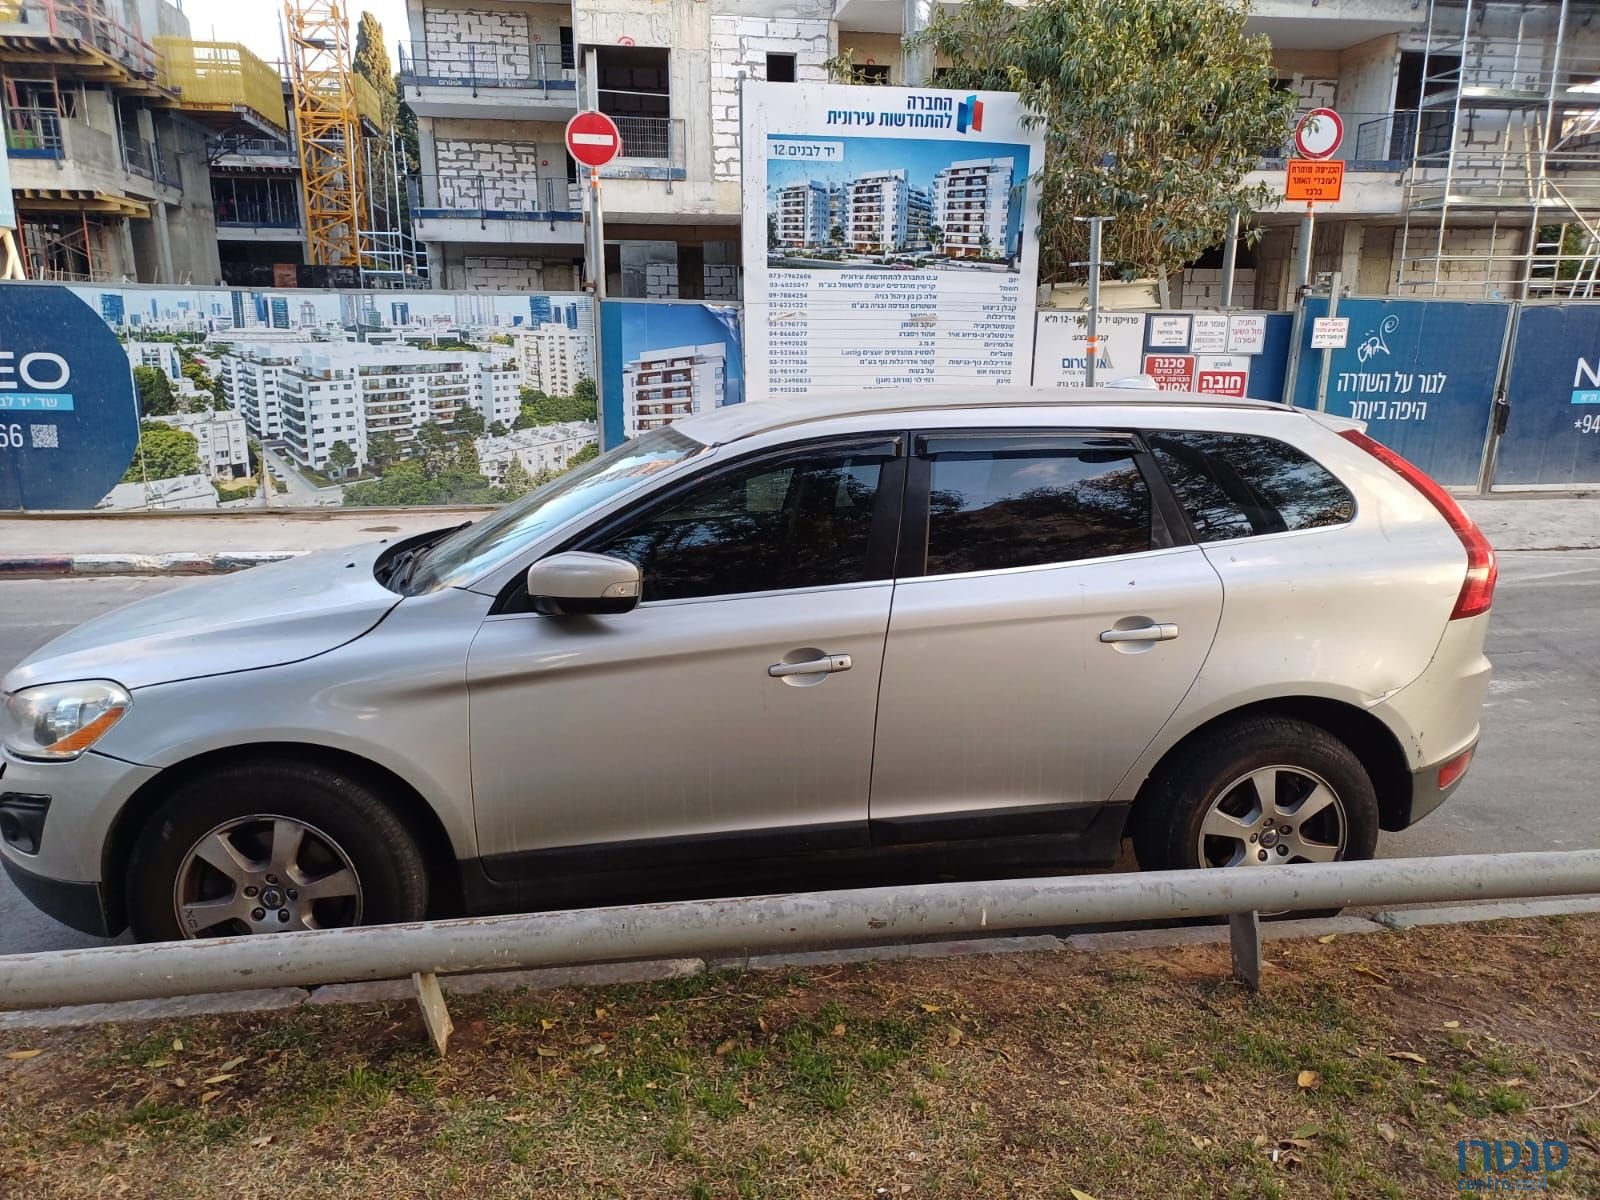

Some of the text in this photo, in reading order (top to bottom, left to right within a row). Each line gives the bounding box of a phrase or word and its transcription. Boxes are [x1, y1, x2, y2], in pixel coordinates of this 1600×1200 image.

[907, 95, 952, 111] החברה
[826, 110, 953, 129] להתחדשות עירונית
[773, 144, 836, 157] יד לבנים 12
[1315, 166, 1340, 174] הכניסה
[1292, 177, 1337, 185] לעובדי האתר
[1304, 188, 1323, 196] בלבד
[986, 313, 1016, 321] אדריכלות
[1044, 314, 1058, 323] ת"א
[1112, 316, 1139, 326] פרוייקט
[1211, 320, 1226, 328] שומר
[1250, 327, 1262, 335] מול
[1155, 358, 1186, 368] סכנה
[1173, 368, 1185, 376] כאן
[1202, 375, 1242, 389] חובה
[1337, 371, 1447, 394] לגור על השדרה
[17, 396, 31, 408] יד
[1349, 400, 1428, 420] היפה ביותר
